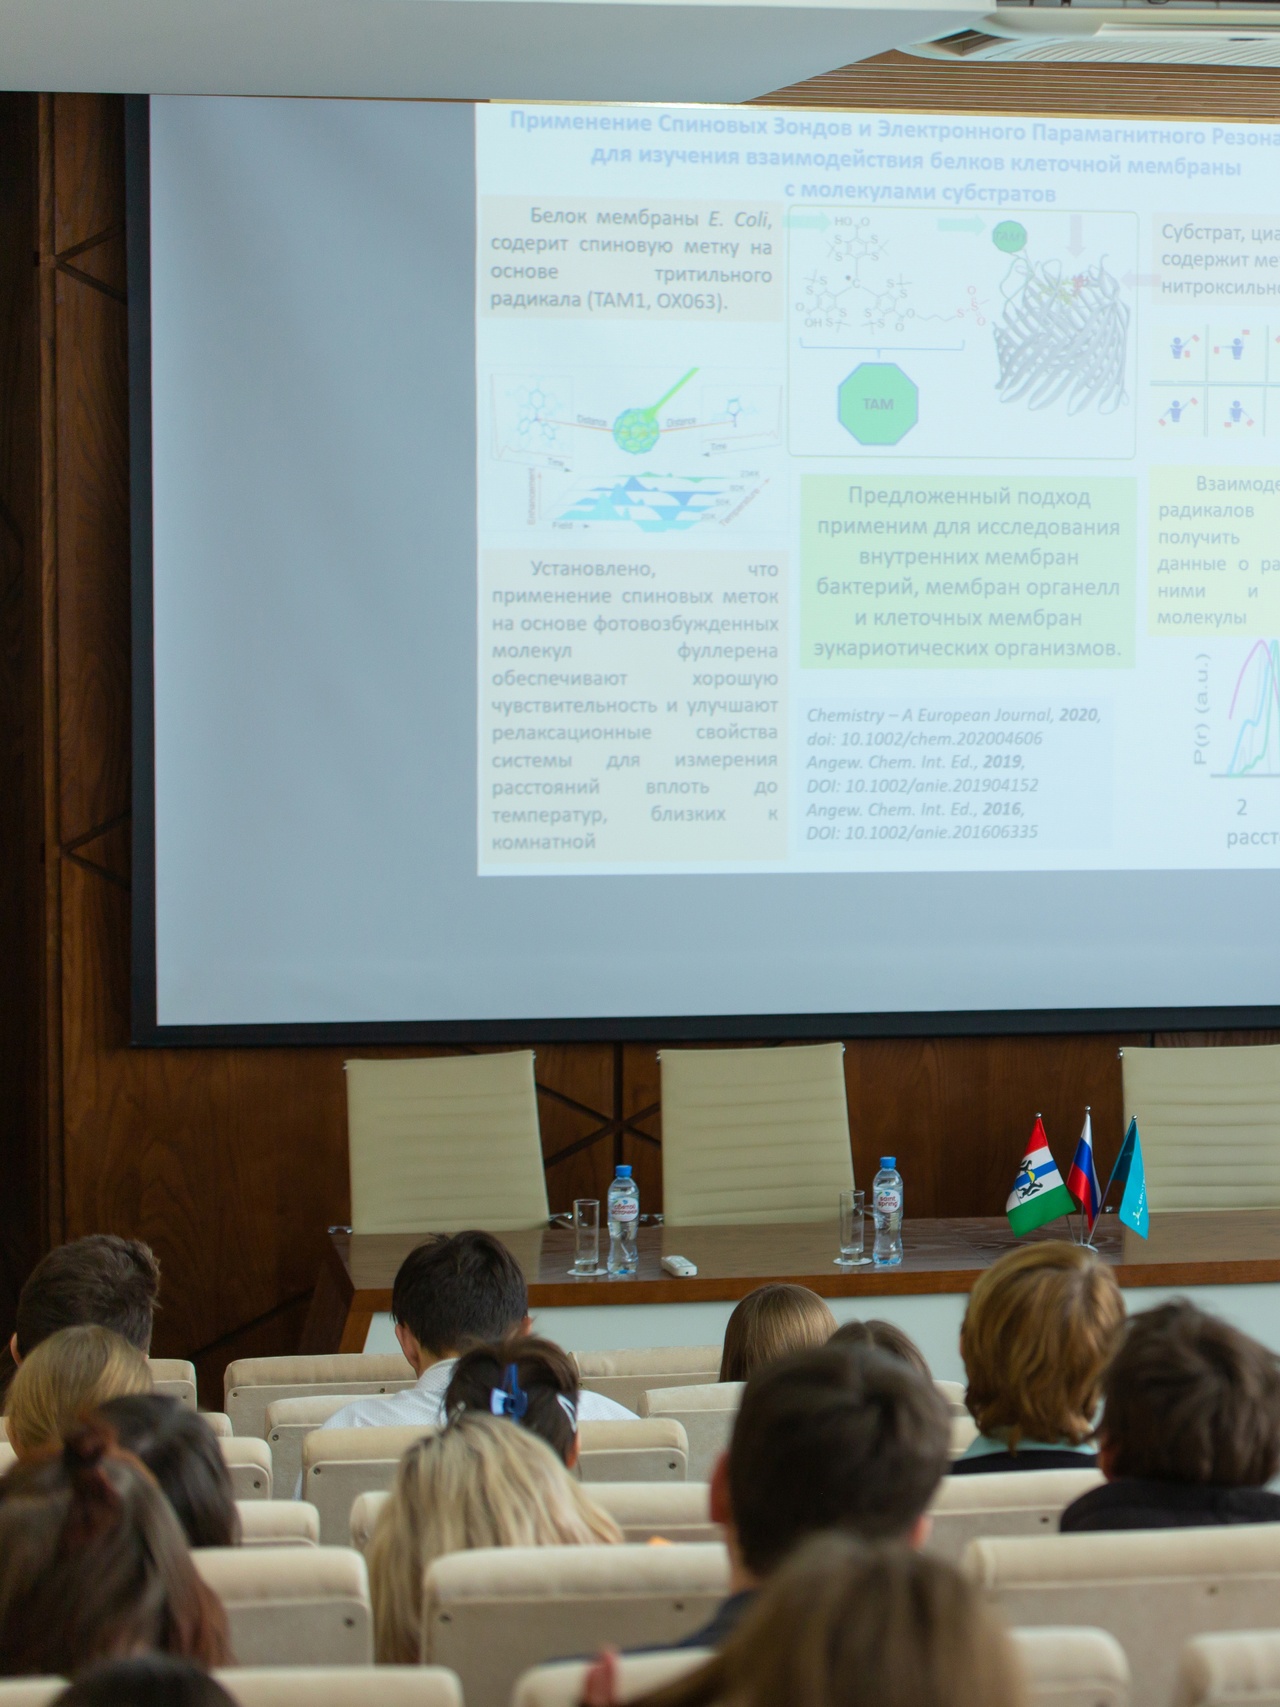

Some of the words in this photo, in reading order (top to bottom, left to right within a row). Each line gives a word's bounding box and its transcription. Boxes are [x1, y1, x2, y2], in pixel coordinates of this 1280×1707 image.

[511, 111, 651, 132] Применение
[658, 116, 767, 136] Спиновых
[774, 117, 852, 140] Зондов
[859, 122, 872, 136] и
[878, 120, 1025, 143] Электронного
[1032, 124, 1205, 149] Парамагнитного
[591, 147, 631, 167] для
[639, 147, 739, 169] изучения
[747, 148, 923, 171] взаимодействия
[930, 152, 1005, 172] белков
[1012, 154, 1121, 176] клеточной
[1128, 158, 1241, 178] мембраны
[786, 184, 795, 198] с
[801, 183, 936, 204] молекулами
[943, 184, 1056, 205] субстратов
[530, 207, 586, 224] Белок
[596, 208, 698, 228] мембраны
[734, 211, 772, 230] Coli,
[1162, 223, 1245, 243] Субстрат,
[490, 237, 568, 254] содерит
[579, 239, 672, 256] спиновую
[684, 241, 739, 258] метку
[750, 243, 772, 255] на
[1161, 254, 1249, 270] содержит
[490, 266, 558, 279] основе
[654, 269, 772, 285] тритильного
[490, 294, 581, 309] радикала
[849, 486, 1010, 507] Предложенный
[1018, 491, 1091, 509] подход
[1159, 505, 1254, 520] радикалов
[818, 520, 927, 537] применим
[933, 521, 970, 538] для
[977, 522, 1120, 538] исследования
[1158, 532, 1240, 548] получить
[859, 551, 978, 568] внутренних
[985, 548, 1078, 568] мембран
[1157, 559, 1226, 573] данные
[1238, 559, 1249, 571] о
[530, 561, 655, 578] Установлено,
[748, 564, 778, 577] что
[816, 576, 918, 598] бактерий,
[925, 577, 1019, 598] мембран
[1026, 582, 1119, 599] органелл
[1158, 586, 1205, 598] ними
[1248, 587, 1258, 598] и
[492, 591, 611, 607] применение
[621, 591, 713, 604] спиновых
[722, 591, 778, 604] меток
[492, 619, 513, 631] на
[520, 619, 587, 631] основе
[593, 615, 778, 635] фотовозбужденных
[855, 613, 866, 625] и
[874, 612, 982, 626] клеточных
[988, 609, 1081, 629] мембран
[1157, 612, 1246, 628] молекулы
[492, 646, 571, 662] молекул
[677, 642, 778, 662] фуллерена
[814, 643, 988, 660] эукариотических
[994, 643, 1121, 659] организмов.
[492, 669, 627, 686] обеспечивают
[692, 674, 778, 689] хорошую
[491, 701, 657, 716] чувствительность
[666, 701, 677, 712] и
[686, 700, 778, 717] улучшают
[807, 708, 885, 725] Chemistry
[902, 708, 912, 721] A
[917, 708, 990, 724] European
[994, 707, 1054, 724] Journal,
[1059, 708, 1100, 723] 2020,
[492, 728, 651, 743] релаксационные
[695, 723, 777, 739] свойства
[806, 732, 835, 746] doi:
[841, 731, 1043, 746] 10.1002/chem.202004606
[492, 756, 572, 768] системы
[605, 755, 640, 770] для
[675, 755, 777, 770] измерения
[806, 755, 862, 773] Angew.
[868, 755, 915, 769] Chem.
[921, 755, 945, 768] Int.
[951, 754, 977, 770] Ed.,
[983, 754, 1024, 769] 2019,
[492, 778, 599, 799] расстояний
[645, 781, 709, 794] вплоть
[753, 781, 778, 796] до
[806, 779, 840, 793] DOI:
[845, 778, 1039, 795] 10.1002/anie.201904152
[492, 810, 607, 826] температур,
[650, 805, 725, 822] близких
[768, 809, 777, 820] к
[805, 803, 862, 820] Angew.
[868, 802, 915, 816] Chem.
[921, 803, 944, 816] Int.
[950, 802, 977, 817] Ed.,
[983, 802, 1024, 817] 2016,
[1237, 798, 1247, 816] 2
[492, 833, 595, 850] комнатной
[806, 826, 840, 840] DOI:
[845, 824, 1038, 841] 10.1002/anie.201606335
